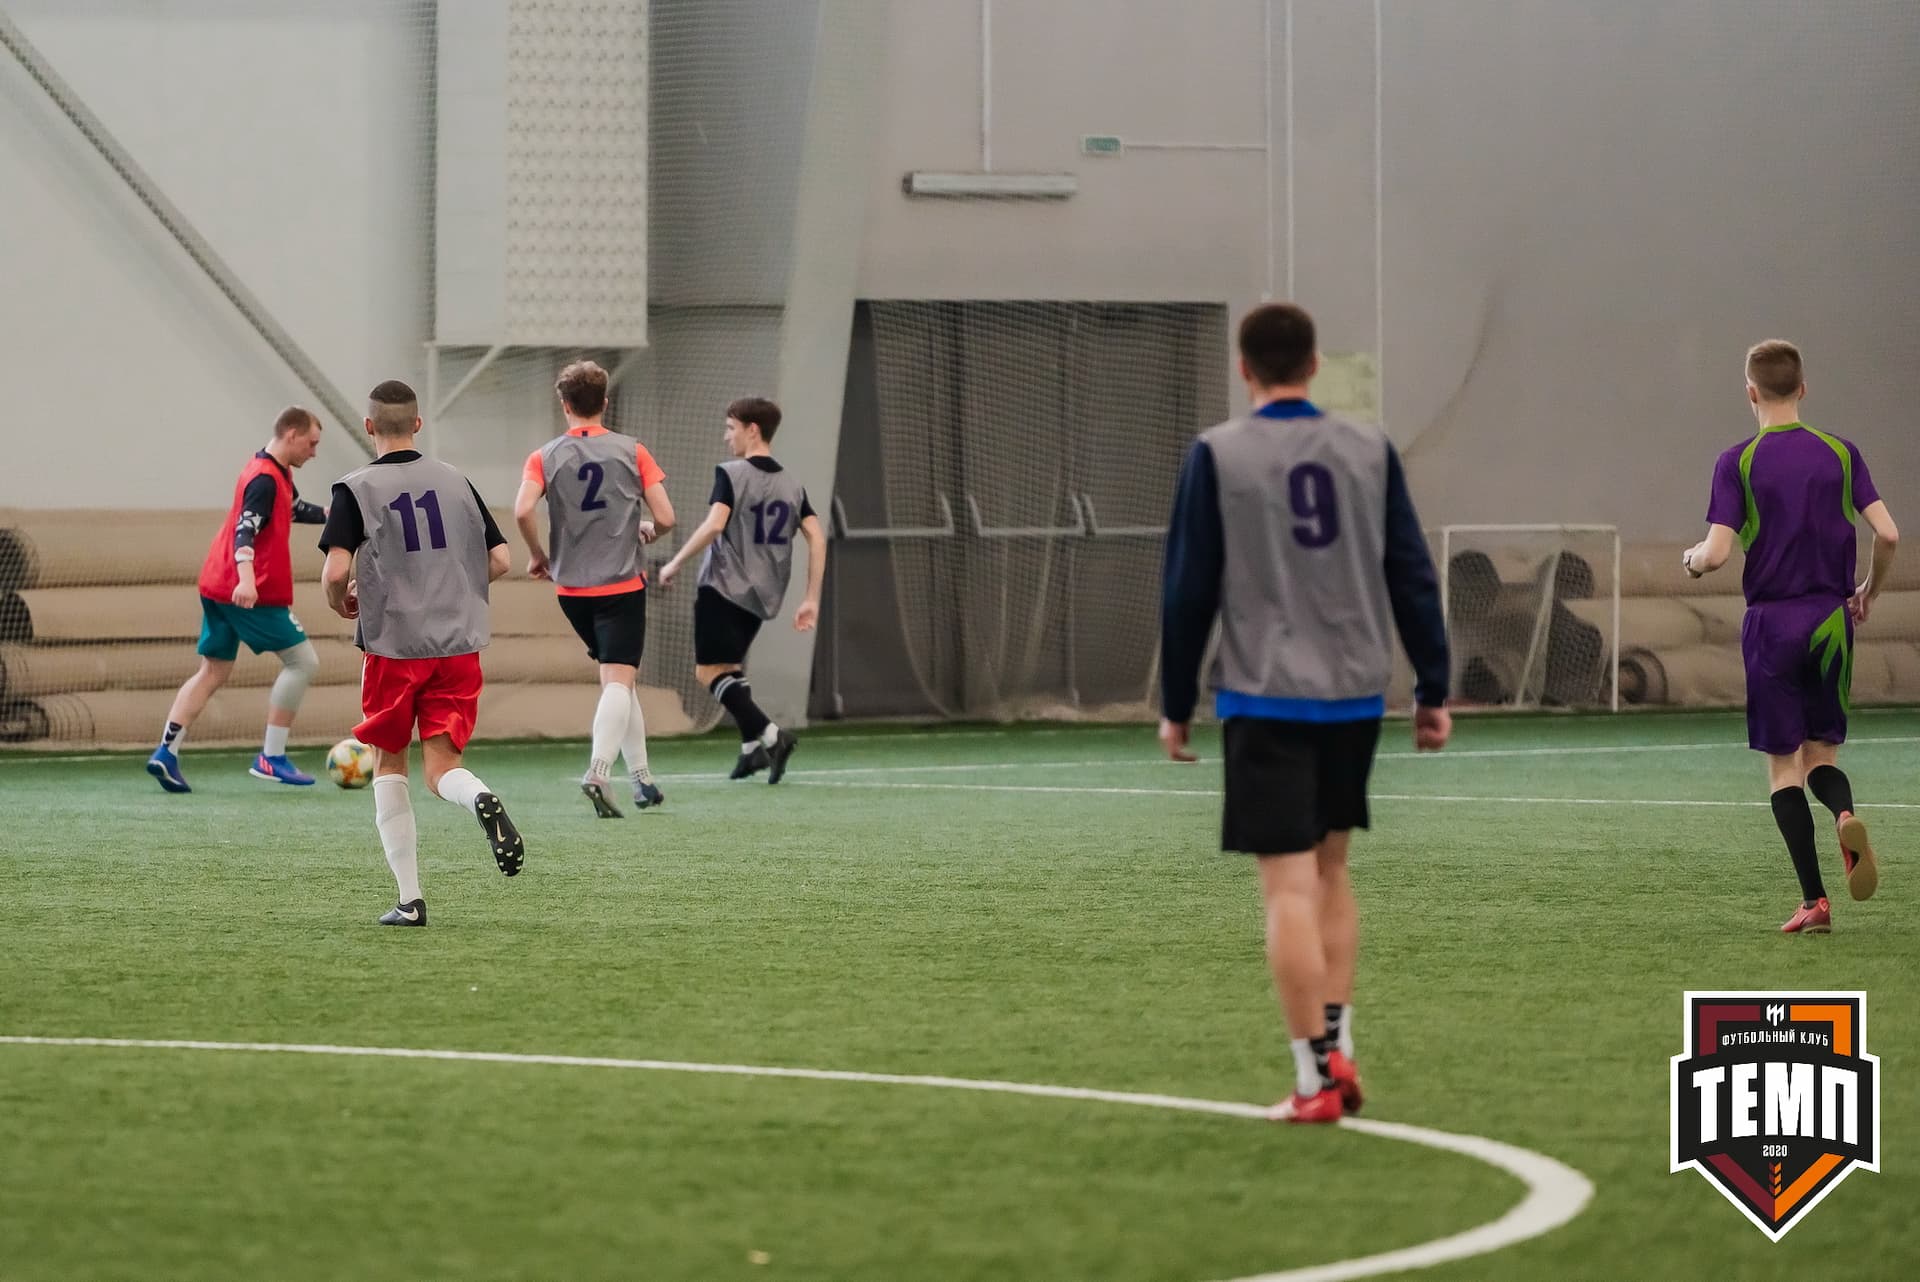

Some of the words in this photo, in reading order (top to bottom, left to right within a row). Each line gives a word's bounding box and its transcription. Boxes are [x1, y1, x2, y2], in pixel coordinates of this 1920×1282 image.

[578, 462, 606, 512] 2
[1288, 462, 1339, 549] 9
[389, 490, 447, 552] 11
[750, 500, 789, 545] 12
